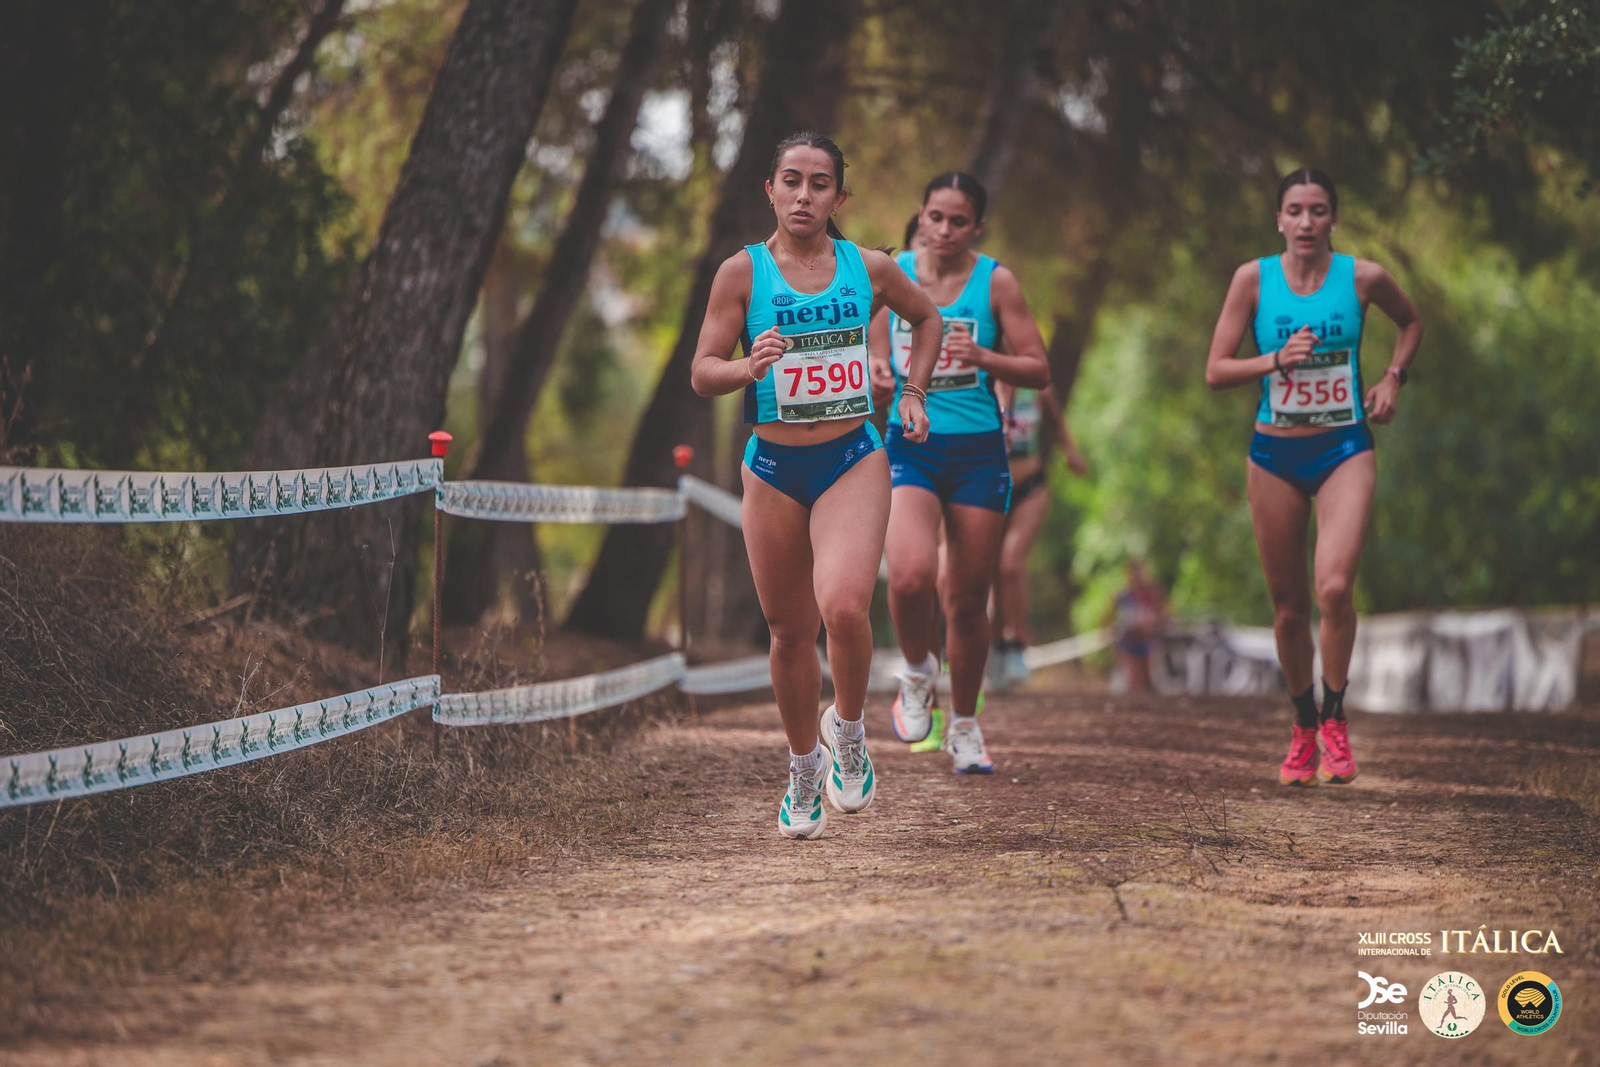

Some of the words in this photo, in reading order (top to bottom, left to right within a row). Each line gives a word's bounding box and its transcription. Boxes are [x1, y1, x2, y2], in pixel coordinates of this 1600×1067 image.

[775, 297, 860, 326] nerja
[801, 334, 844, 347] ITÁLICA
[783, 360, 863, 397] 7590
[1278, 379, 1348, 406] 7556
[758, 455, 777, 466] nerja
